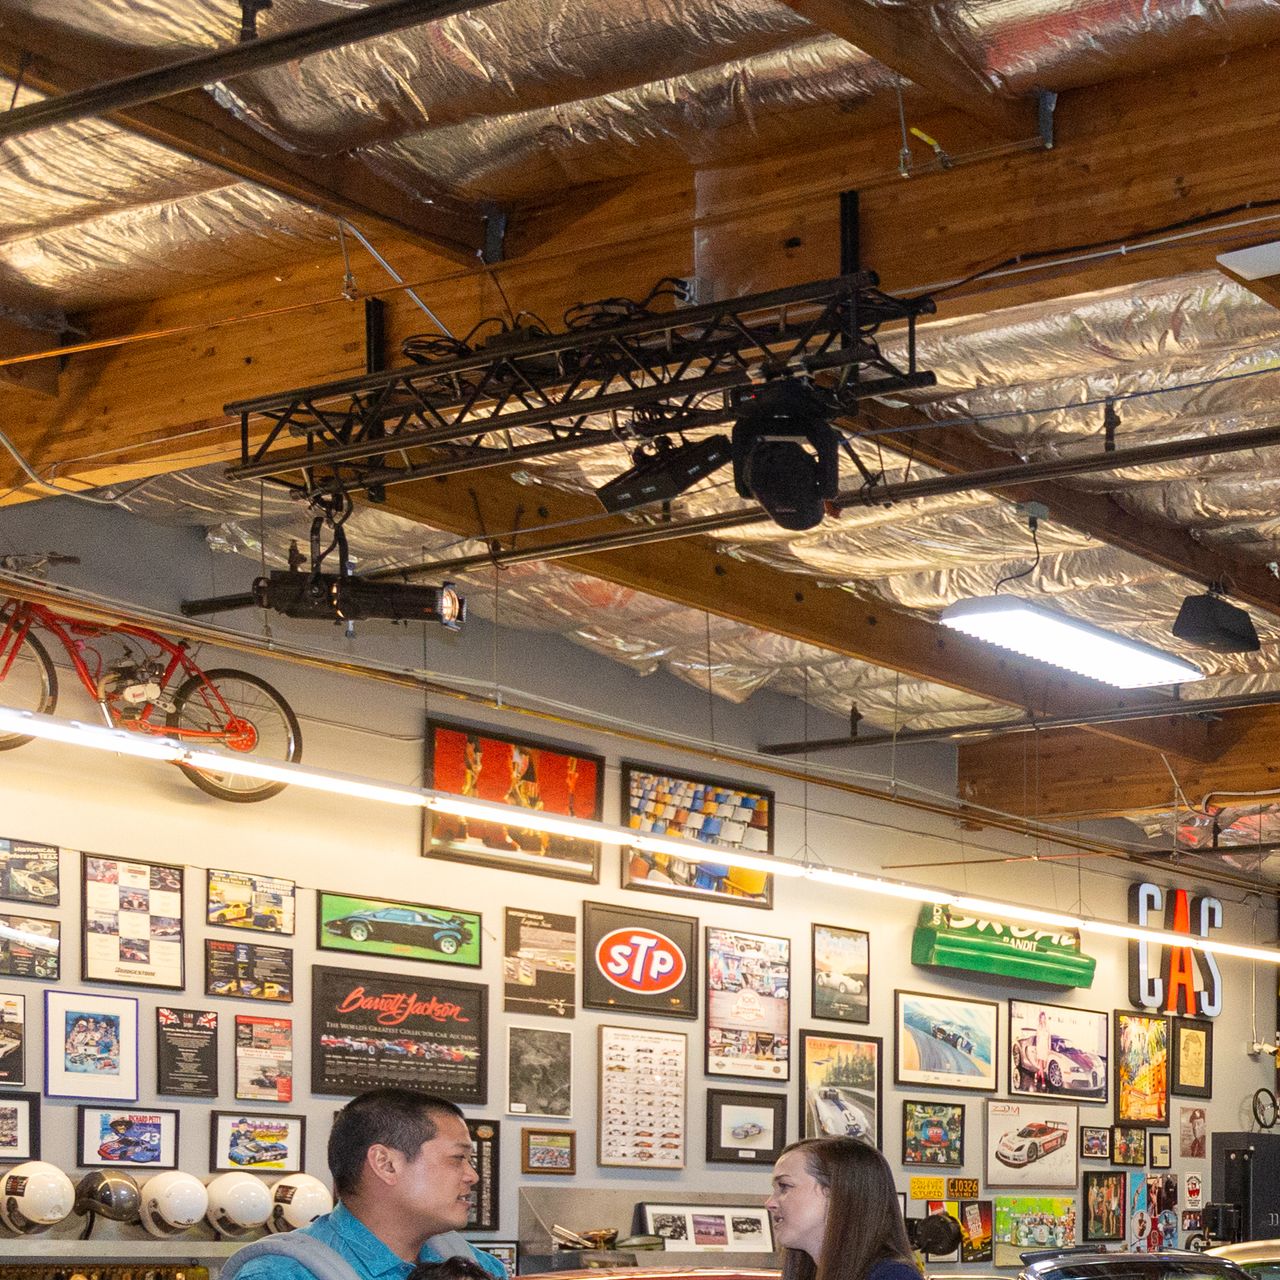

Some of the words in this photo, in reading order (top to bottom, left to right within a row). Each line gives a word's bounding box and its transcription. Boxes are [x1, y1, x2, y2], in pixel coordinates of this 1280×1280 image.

[606, 935, 675, 984] STP
[1130, 882, 1223, 1017] CAS
[336, 986, 470, 1025] Barrett-Jackson
[141, 1132, 160, 1145] 43
[949, 1179, 978, 1192] CJ0326
